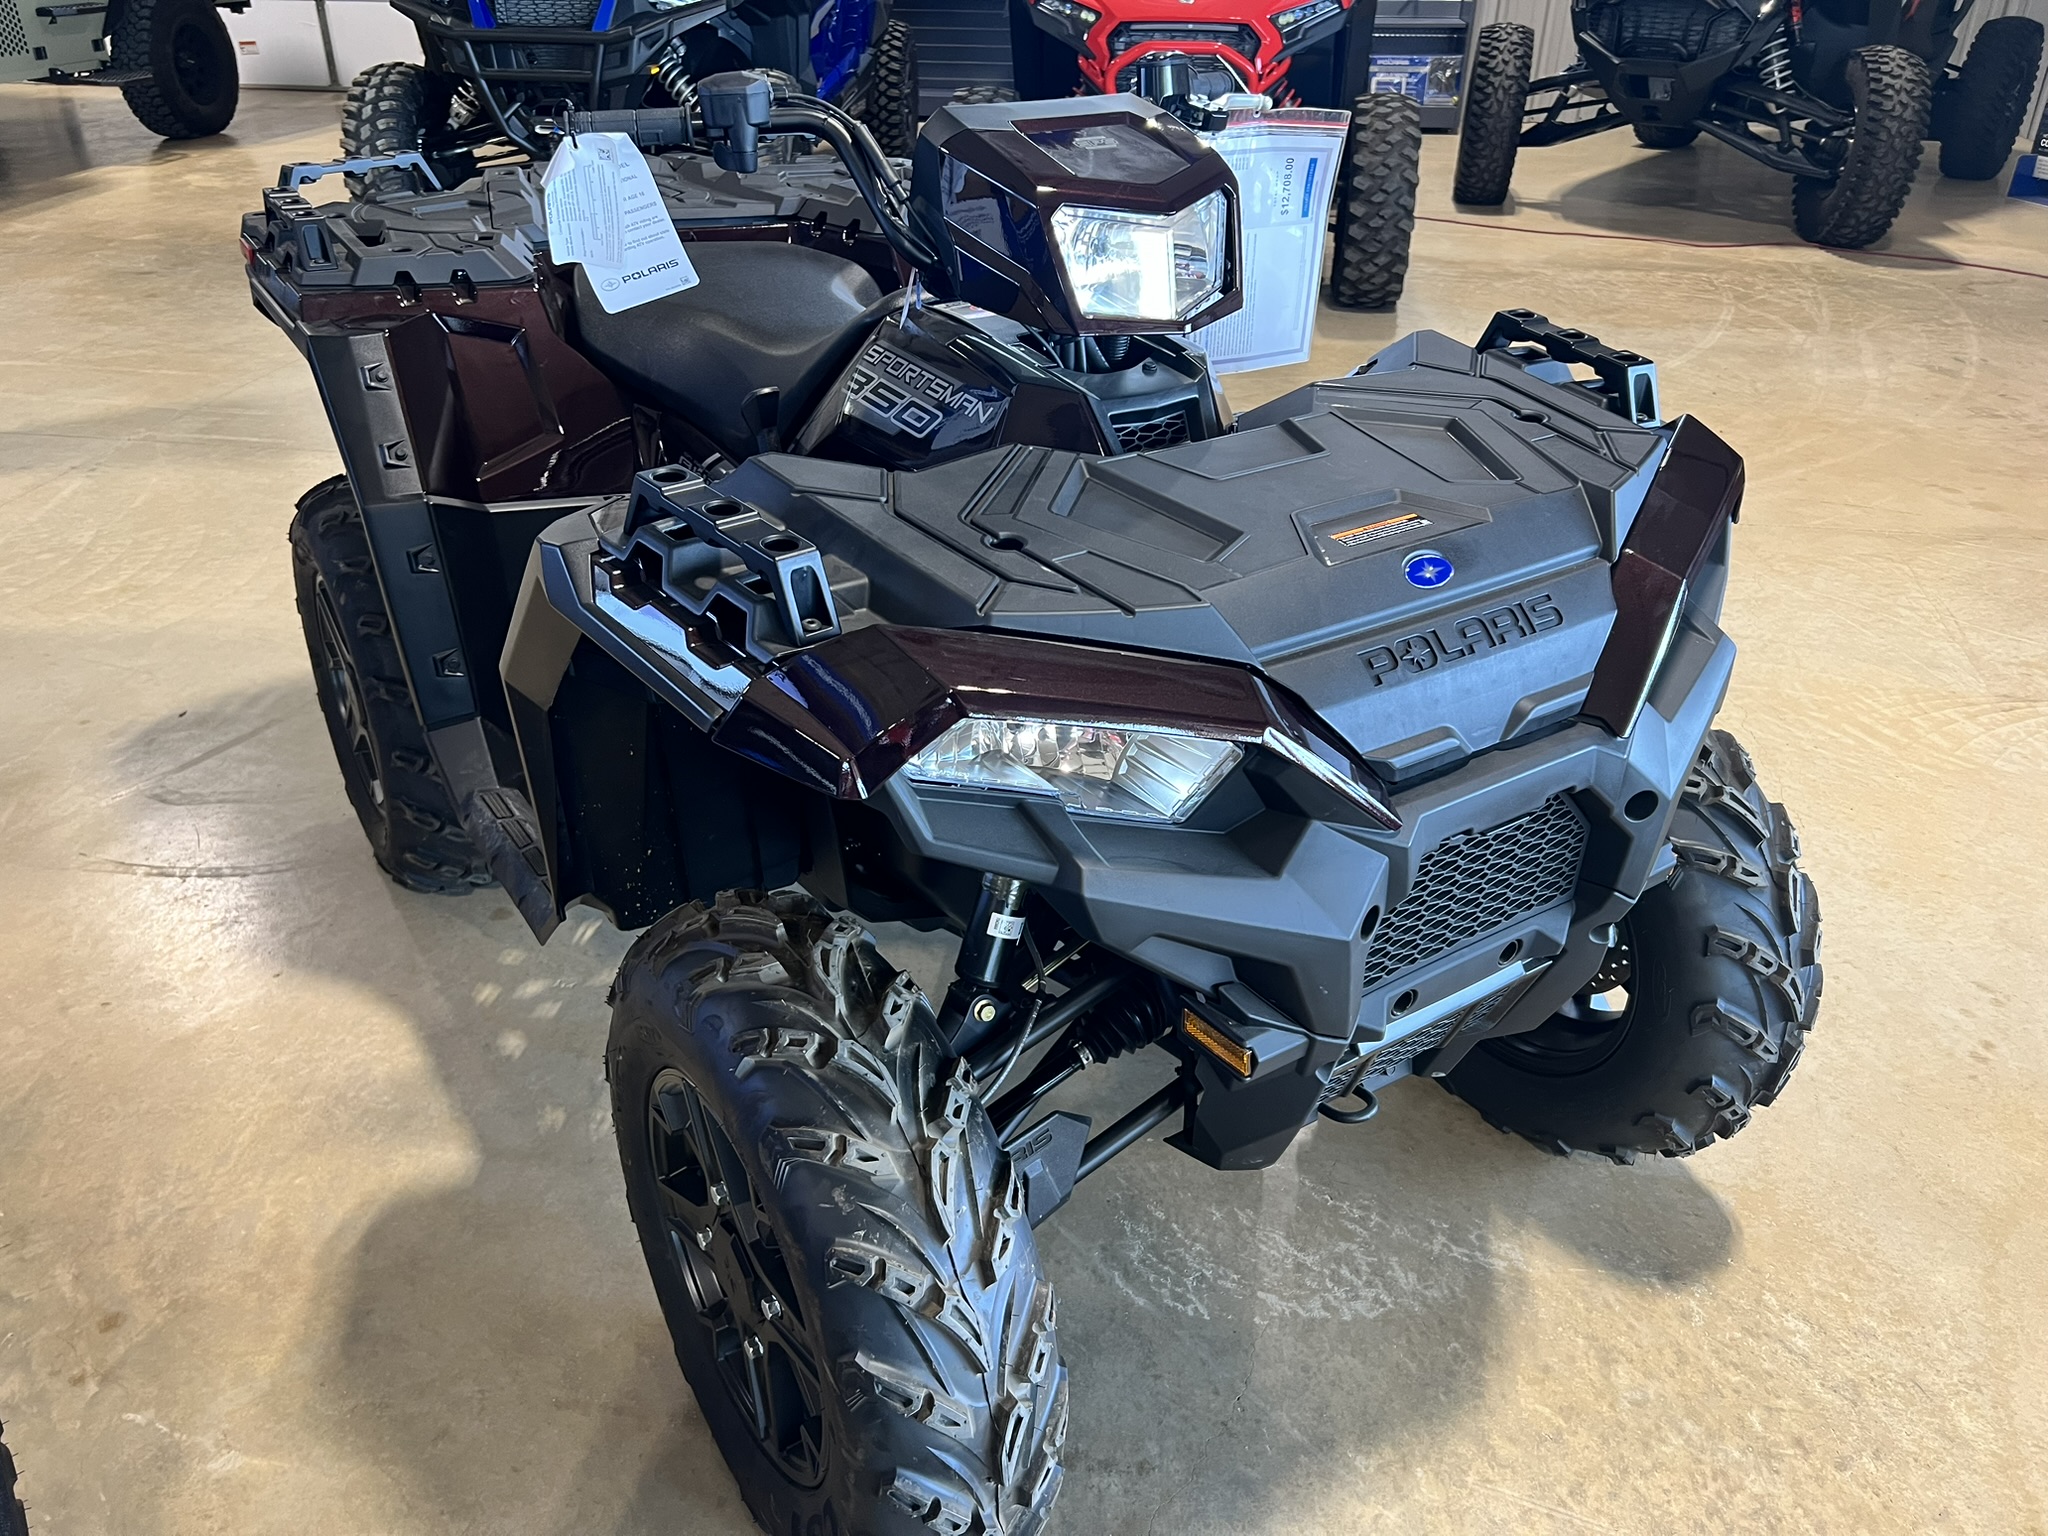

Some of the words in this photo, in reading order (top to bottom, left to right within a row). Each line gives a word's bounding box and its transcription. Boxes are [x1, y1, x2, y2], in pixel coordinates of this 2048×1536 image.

[624, 201, 657, 215] PASSENGERS
[1280, 157, 1295, 216] $12,708.00
[621, 258, 679, 284] POLARIS
[862, 344, 994, 424] SPORTSMAN
[1356, 592, 1564, 687] POLARIS
